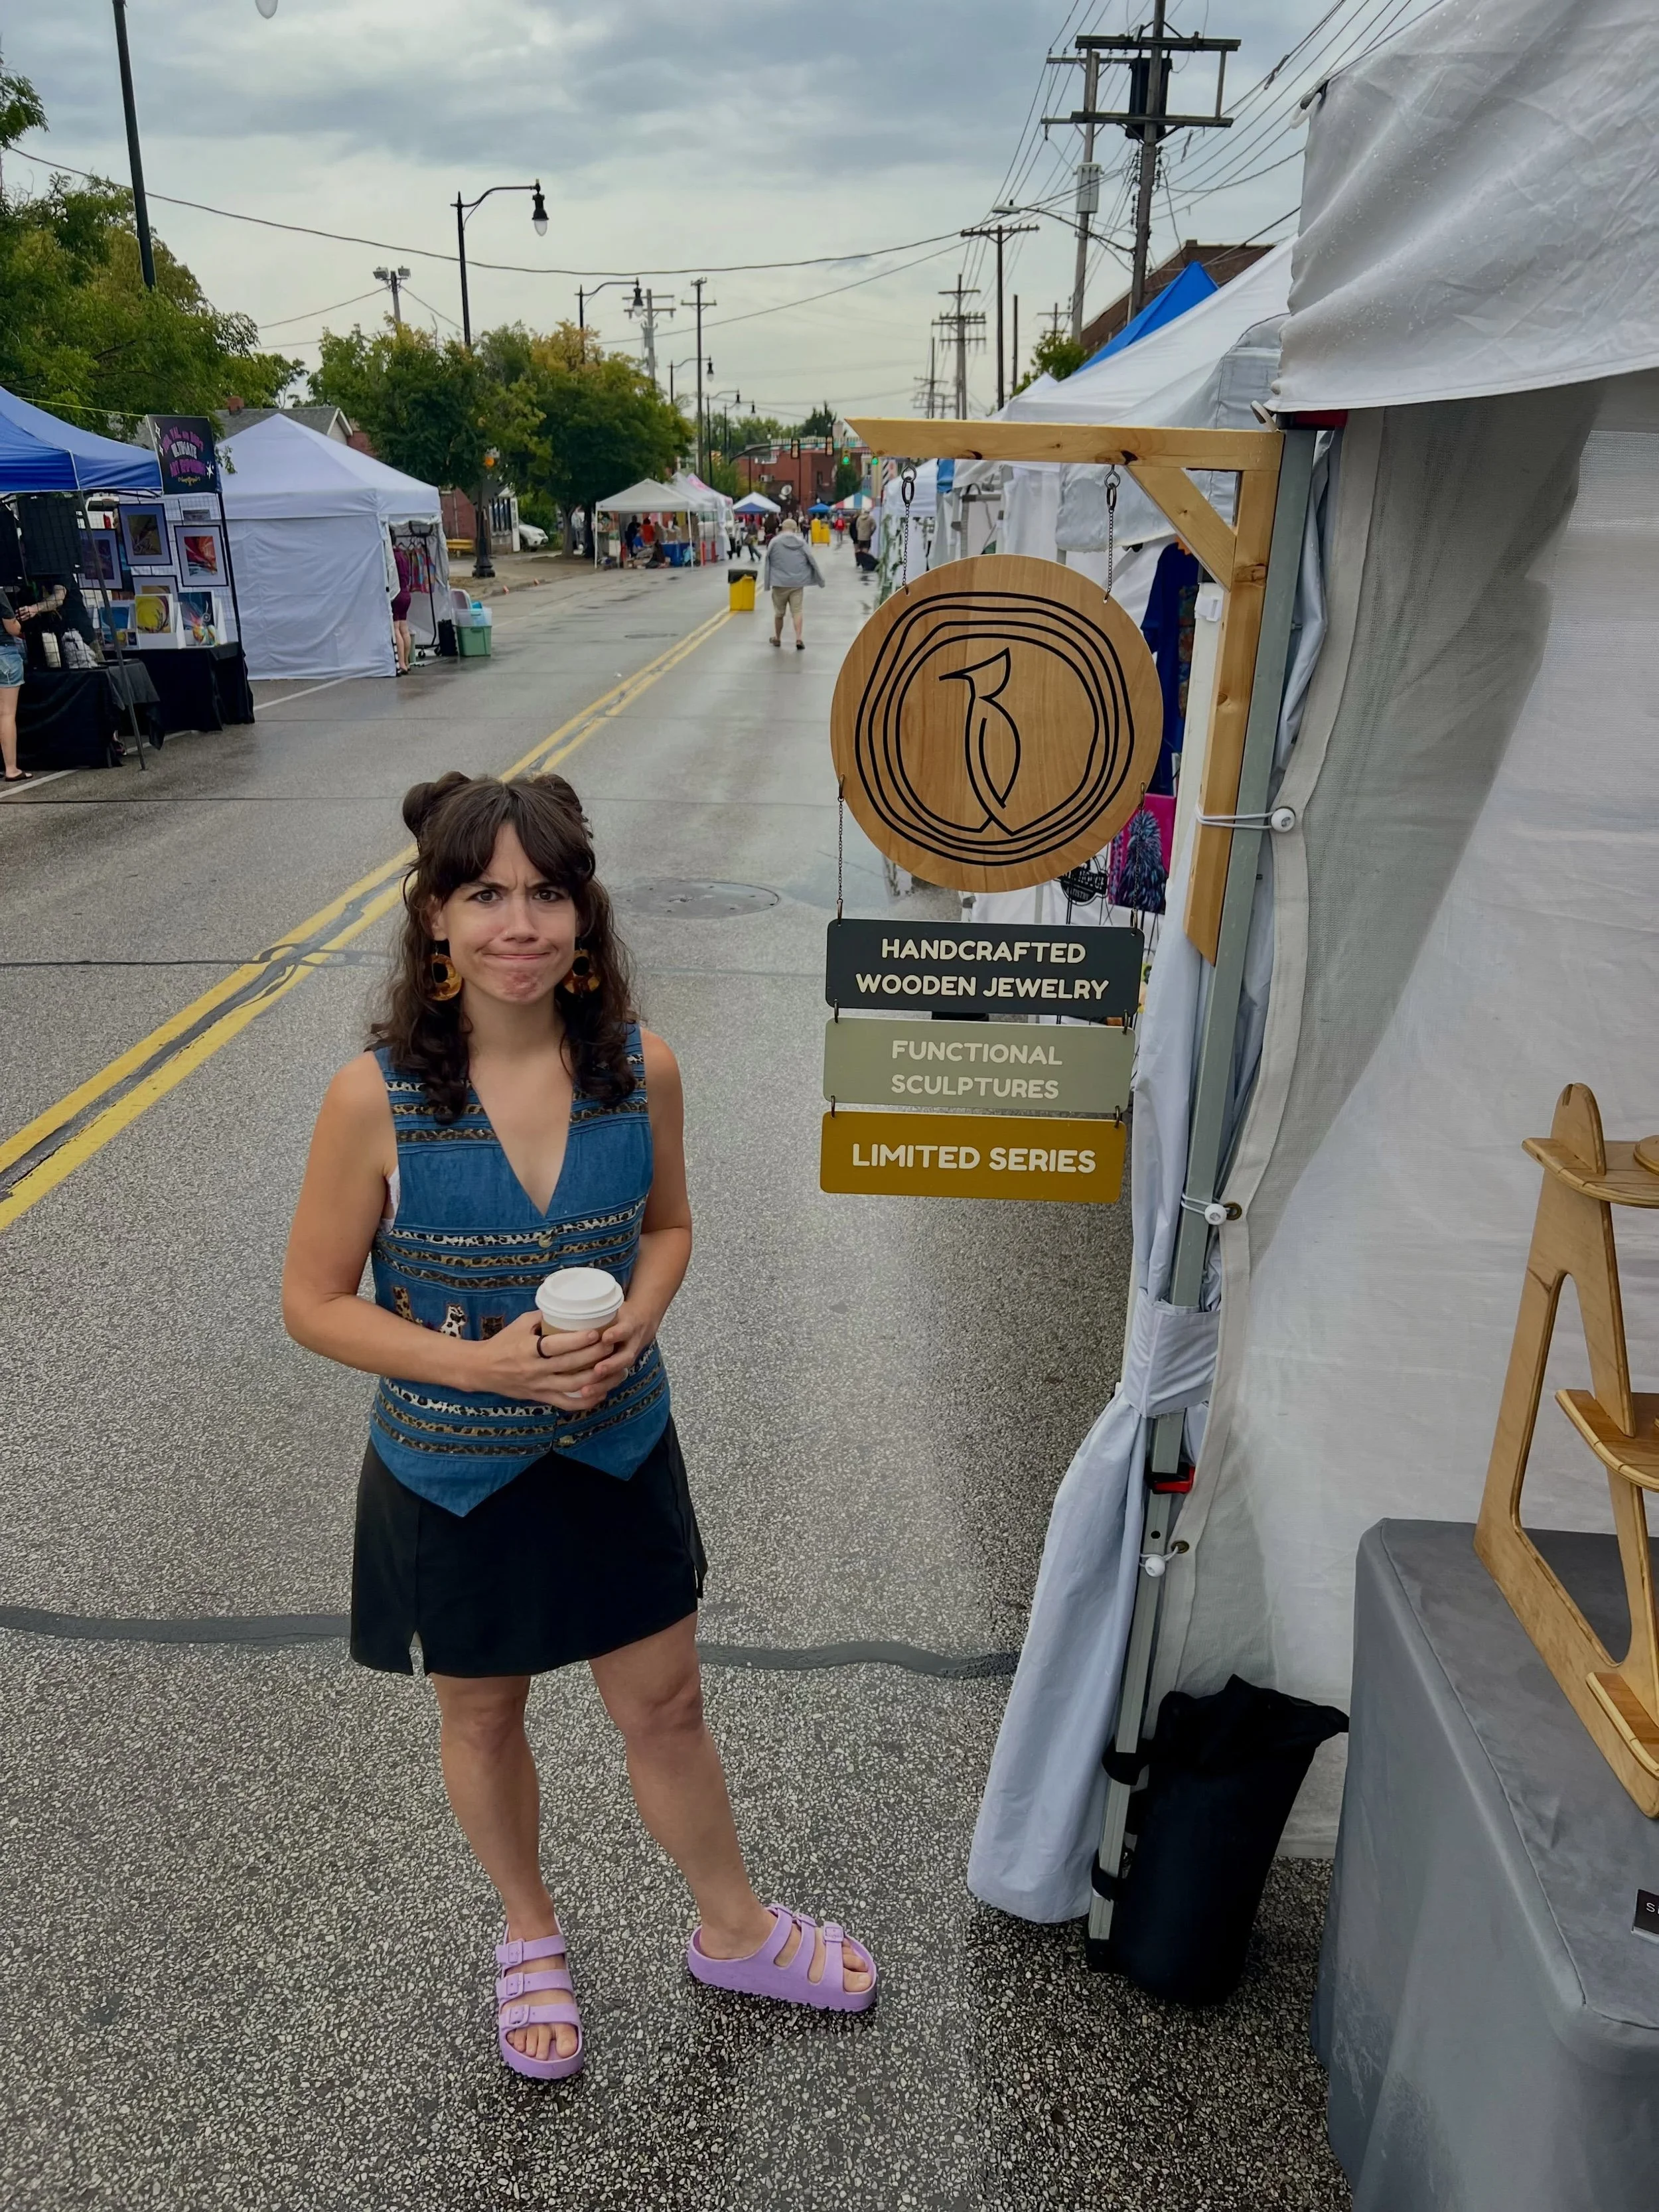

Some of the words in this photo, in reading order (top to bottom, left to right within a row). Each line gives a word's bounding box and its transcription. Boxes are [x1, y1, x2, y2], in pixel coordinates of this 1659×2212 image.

[881, 938, 1086, 964] HANDCRAFTED
[855, 973, 976, 996] WOODEN
[982, 977, 1110, 999] JEWELRY
[892, 1040, 1063, 1065] FUNCTIONAL
[891, 1074, 1059, 1099] SCULPTURES
[853, 1143, 980, 1169] LIMITED
[989, 1147, 1096, 1173] SERIES
